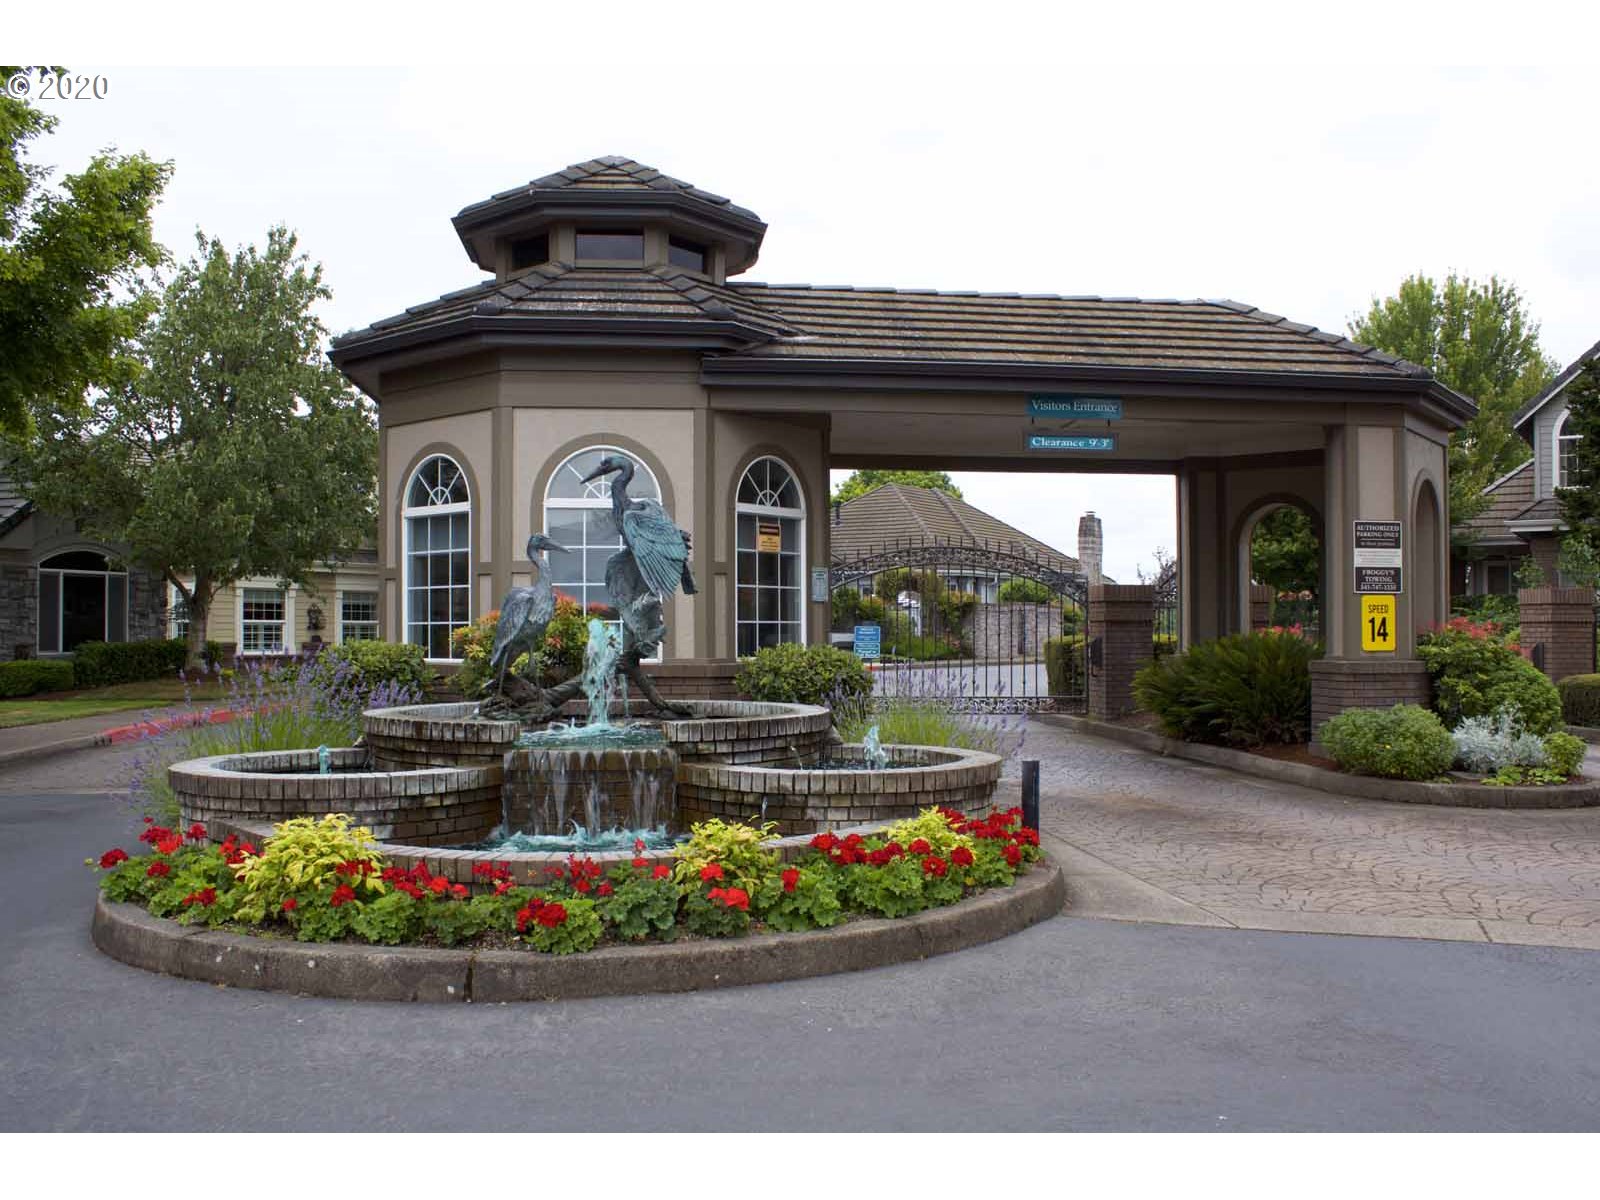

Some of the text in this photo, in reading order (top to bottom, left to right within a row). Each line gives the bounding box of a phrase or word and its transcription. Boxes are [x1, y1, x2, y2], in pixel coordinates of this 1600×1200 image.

[1032, 400, 1118, 412] Visitors Entrance
[1031, 437, 1084, 447] Clearance
[1367, 604, 1389, 614] SPEED
[1368, 616, 1389, 642] 14
